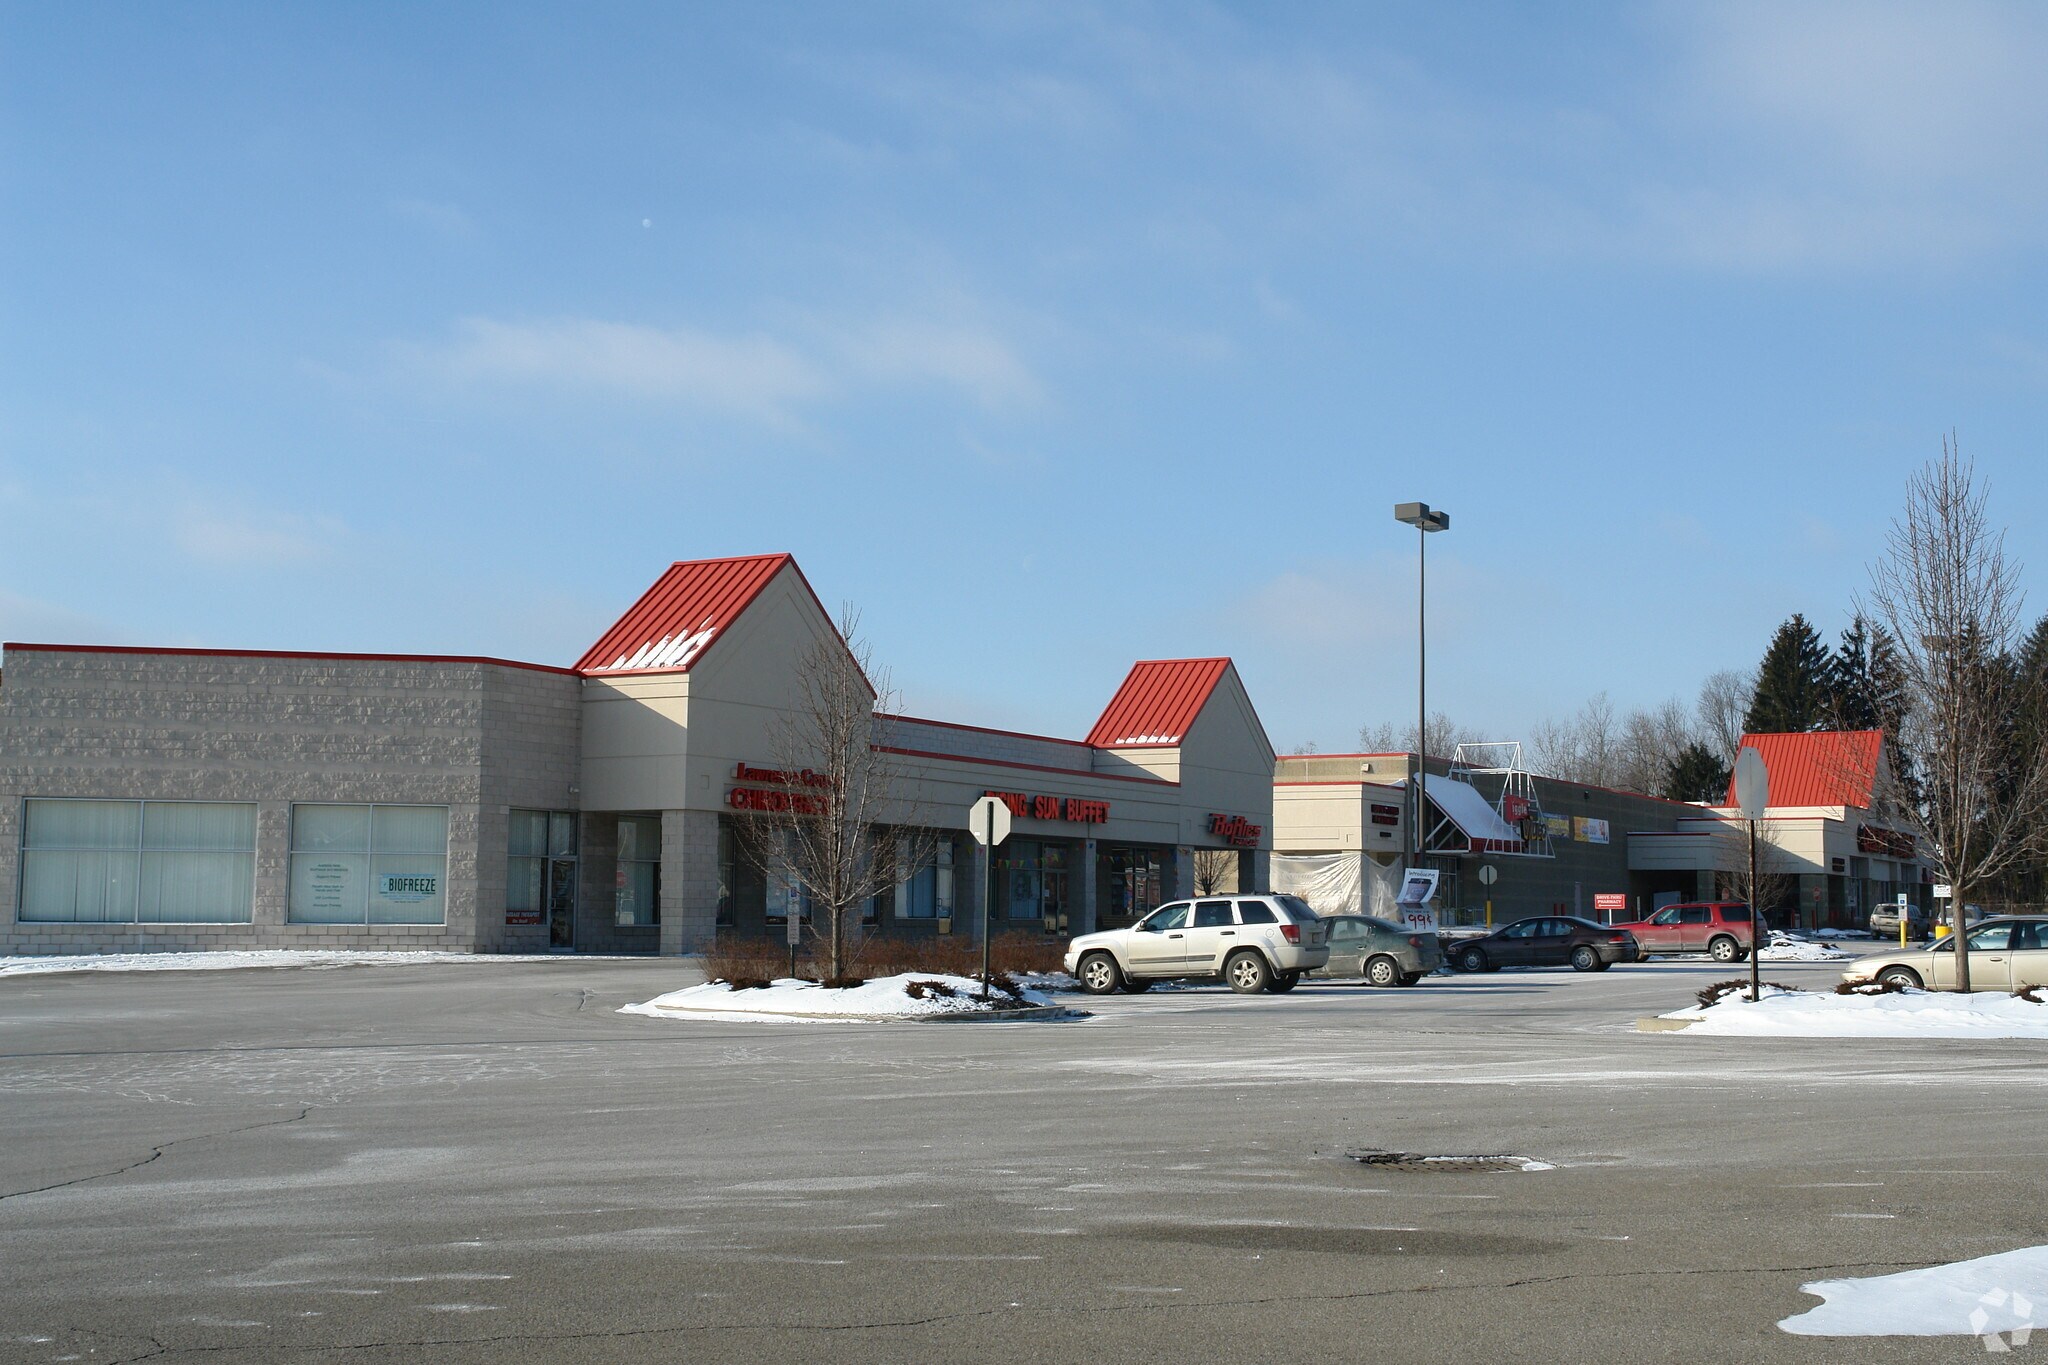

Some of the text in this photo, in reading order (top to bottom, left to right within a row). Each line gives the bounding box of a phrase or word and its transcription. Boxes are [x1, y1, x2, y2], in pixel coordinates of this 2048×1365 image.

[1034, 795, 1060, 819] SUN
[1065, 797, 1111, 824] BUFFET
[388, 878, 437, 892] BIOFREEZE
